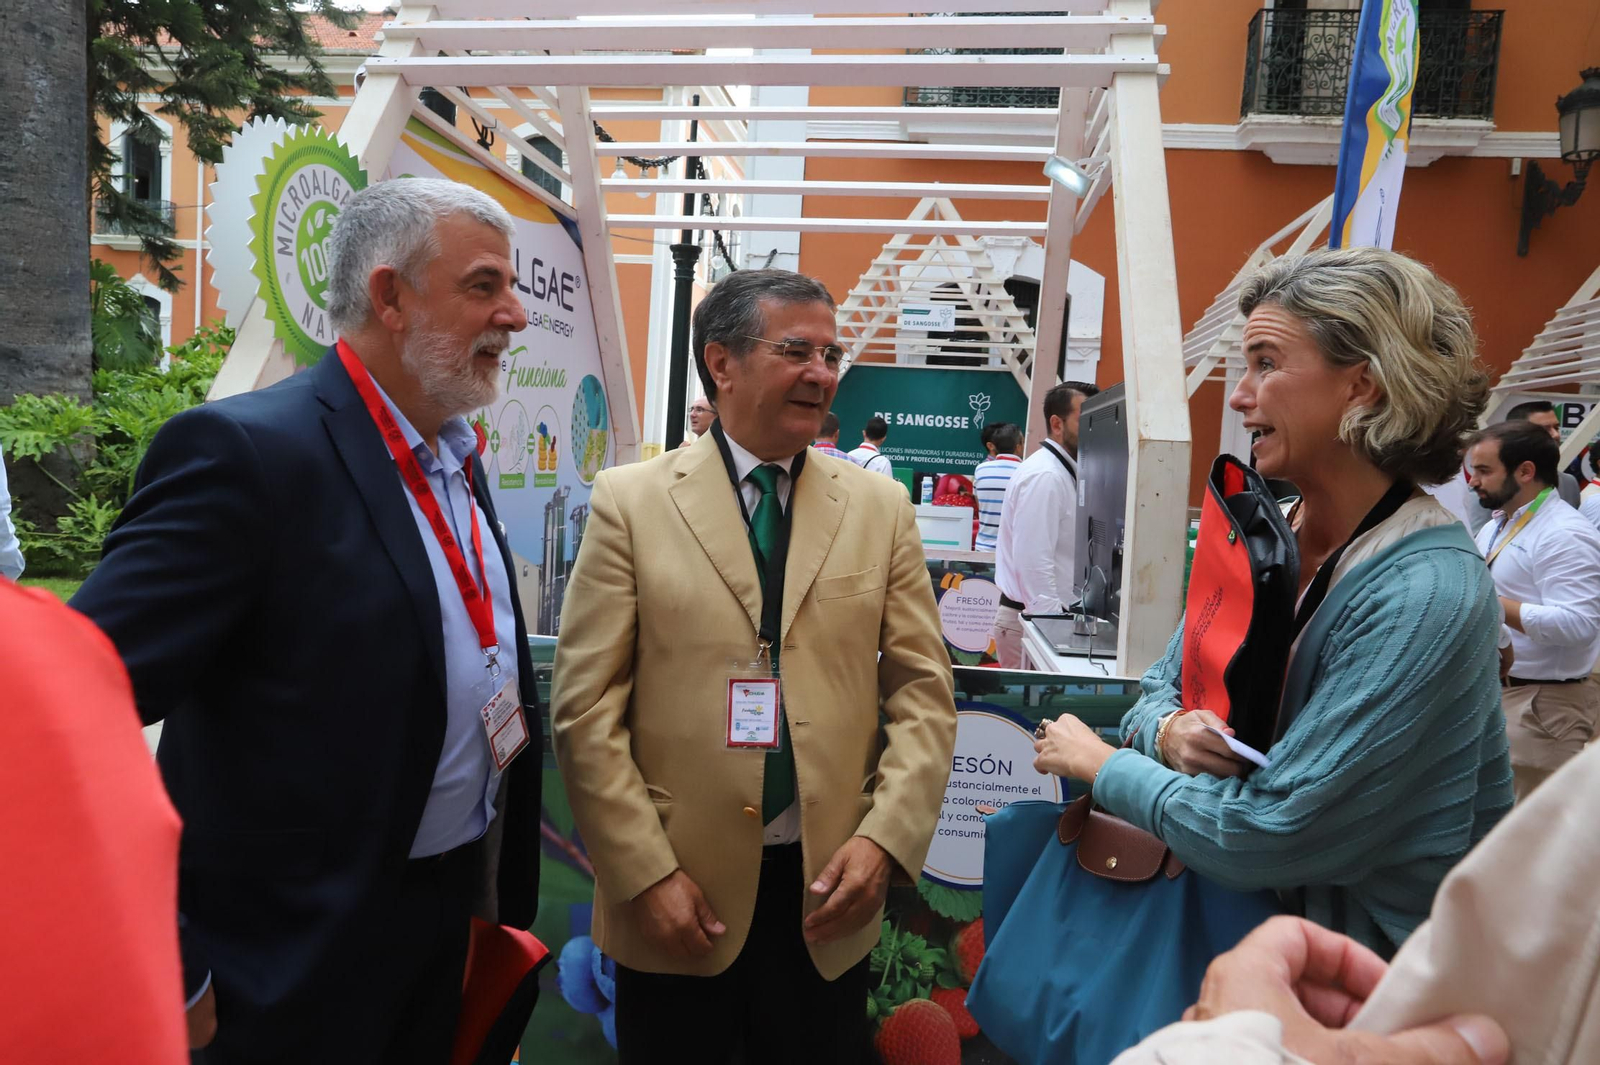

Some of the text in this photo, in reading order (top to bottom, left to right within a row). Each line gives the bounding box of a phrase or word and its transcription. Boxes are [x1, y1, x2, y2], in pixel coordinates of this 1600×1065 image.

[524, 309, 574, 338] LGAENERGY
[506, 345, 567, 394] Funciona
[896, 413, 969, 429] SANGOSSE
[880, 446, 903, 454] LUCIONES
[904, 448, 940, 456] INNOVADORAS
[945, 450, 976, 458] DURADERAS
[911, 456, 945, 464] PROTECCIÓN
[956, 596, 993, 606] FRESÓN
[952, 753, 1012, 776] ESÓN
[945, 780, 1041, 795] ustancialmente el
[947, 813, 954, 822] y
